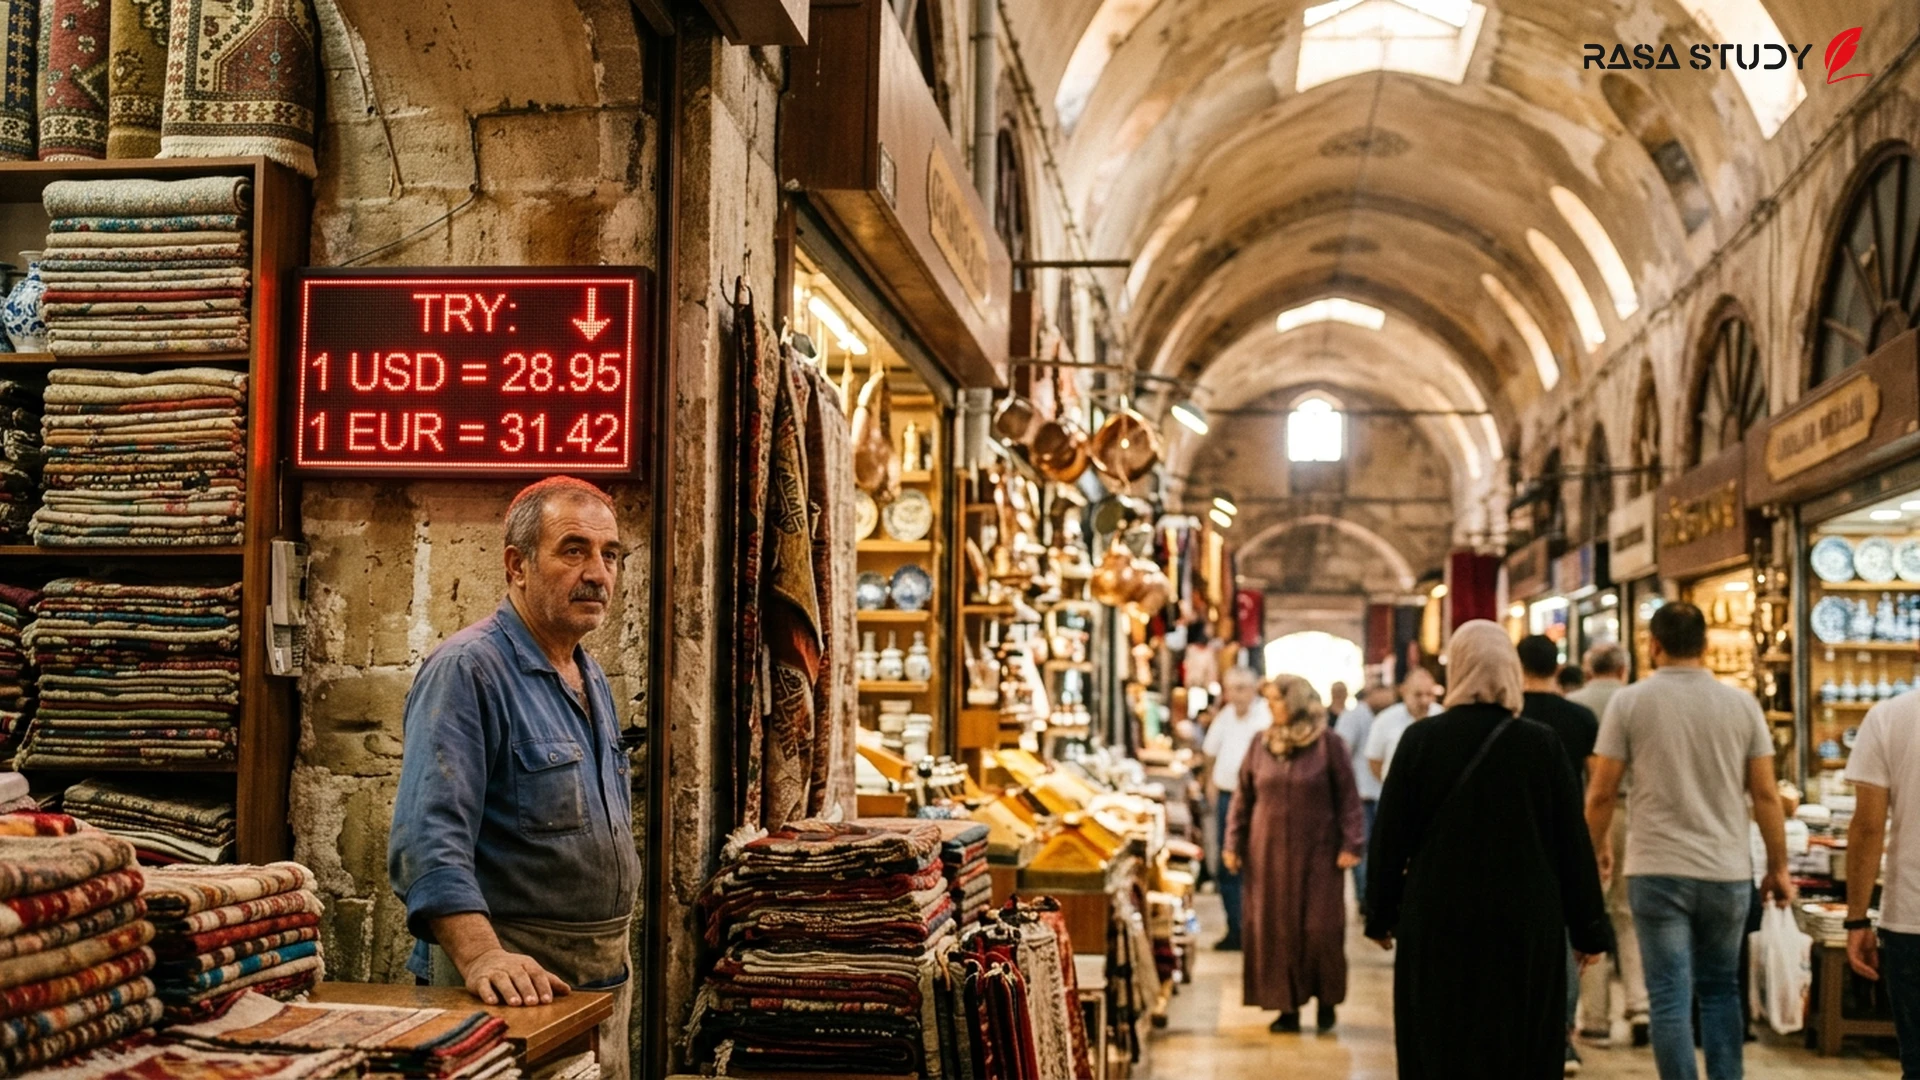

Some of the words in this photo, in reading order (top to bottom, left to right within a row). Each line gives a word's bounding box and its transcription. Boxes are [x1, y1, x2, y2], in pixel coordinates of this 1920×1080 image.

[412, 293, 517, 333] TRY:
[312, 352, 328, 391] 1
[350, 352, 446, 392] USD
[461, 362, 487, 382] =
[501, 352, 622, 392] 28.95
[310, 411, 326, 451] 1
[348, 412, 444, 452] EUR
[459, 423, 485, 442] =
[499, 413, 619, 453] 31.42
